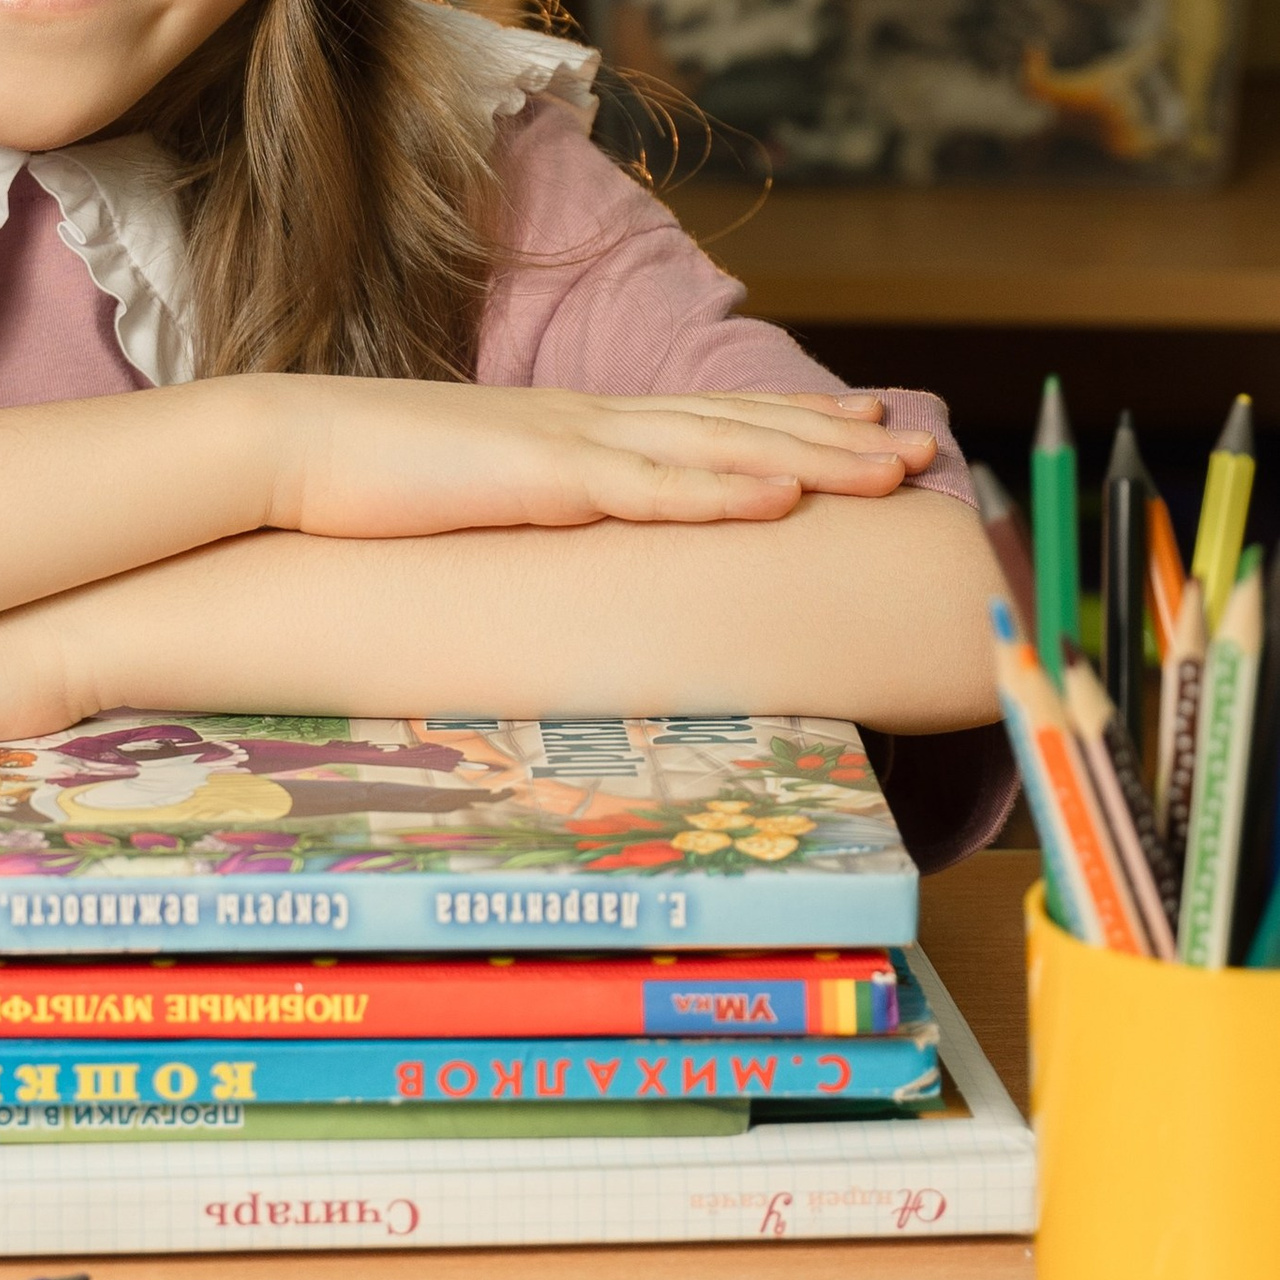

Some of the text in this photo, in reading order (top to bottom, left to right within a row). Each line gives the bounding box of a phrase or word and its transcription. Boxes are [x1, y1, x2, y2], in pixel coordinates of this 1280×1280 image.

[217, 891, 349, 930] Секреты
[436, 890, 687, 928] Е. Лаврентьева
[165, 994, 370, 1023] ЛЮБИМЫЕ
[44, 1105, 62, 1127] В
[73, 1105, 240, 1127] ПРОГУЛКИ
[204, 1191, 420, 1237] Считарь
